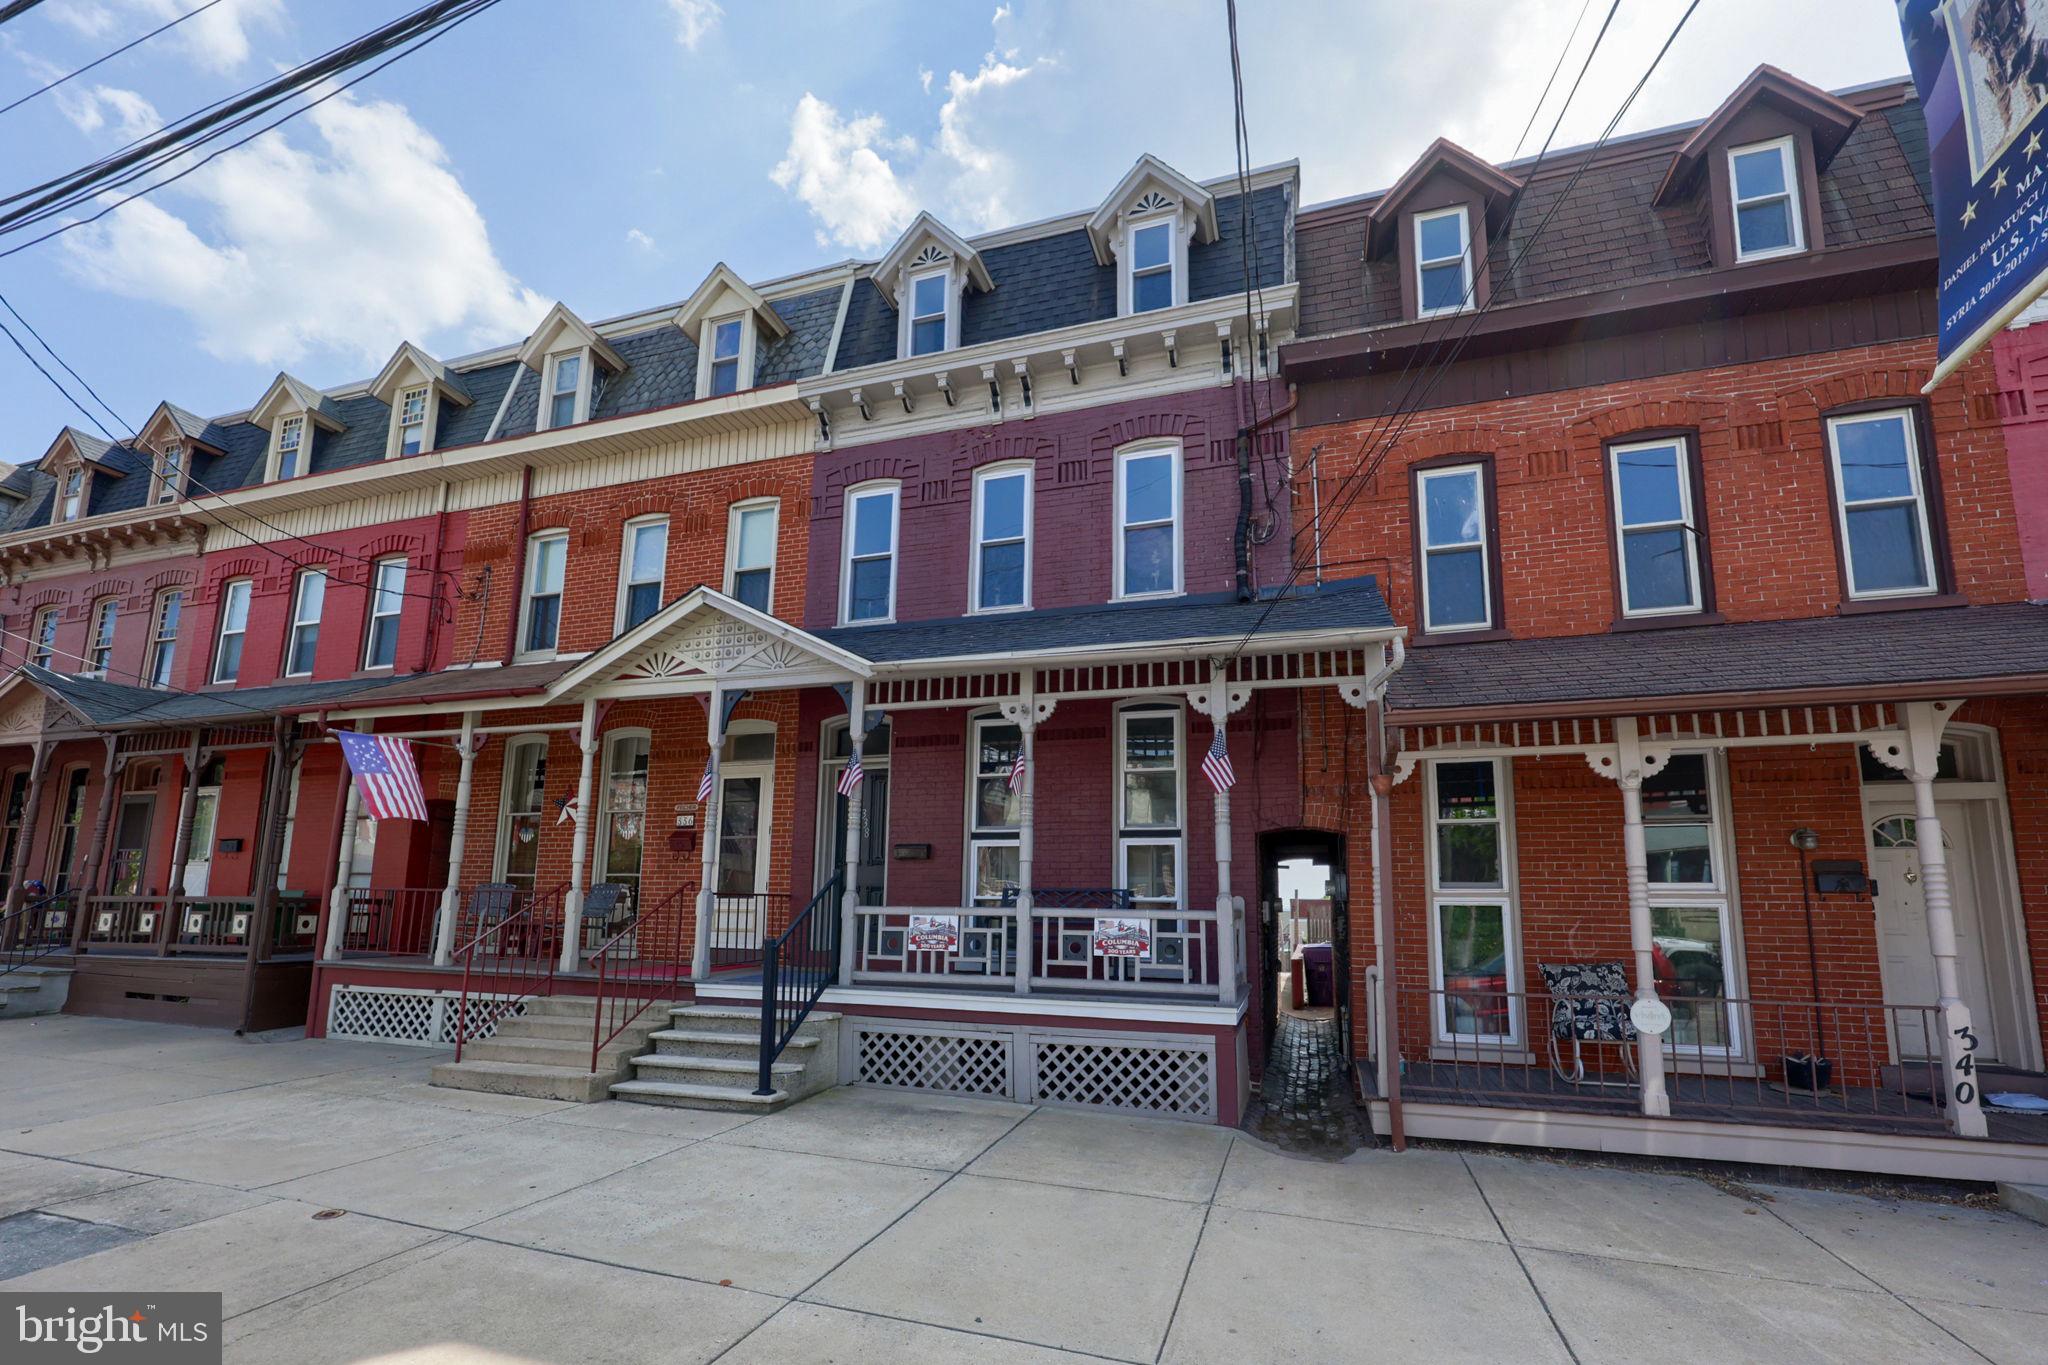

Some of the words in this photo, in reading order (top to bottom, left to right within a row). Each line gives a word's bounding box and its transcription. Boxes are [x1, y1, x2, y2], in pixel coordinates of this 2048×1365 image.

[1944, 252, 1979, 291] DANIEL
[1980, 190, 2040, 255] PALATUCCI
[1991, 230, 2024, 267] U.S.
[1946, 296, 1977, 331] SYRIA
[1979, 246, 2030, 300] 2015-2019
[915, 934, 949, 942] COLUMBIA
[1954, 1026, 1979, 1105] 340
